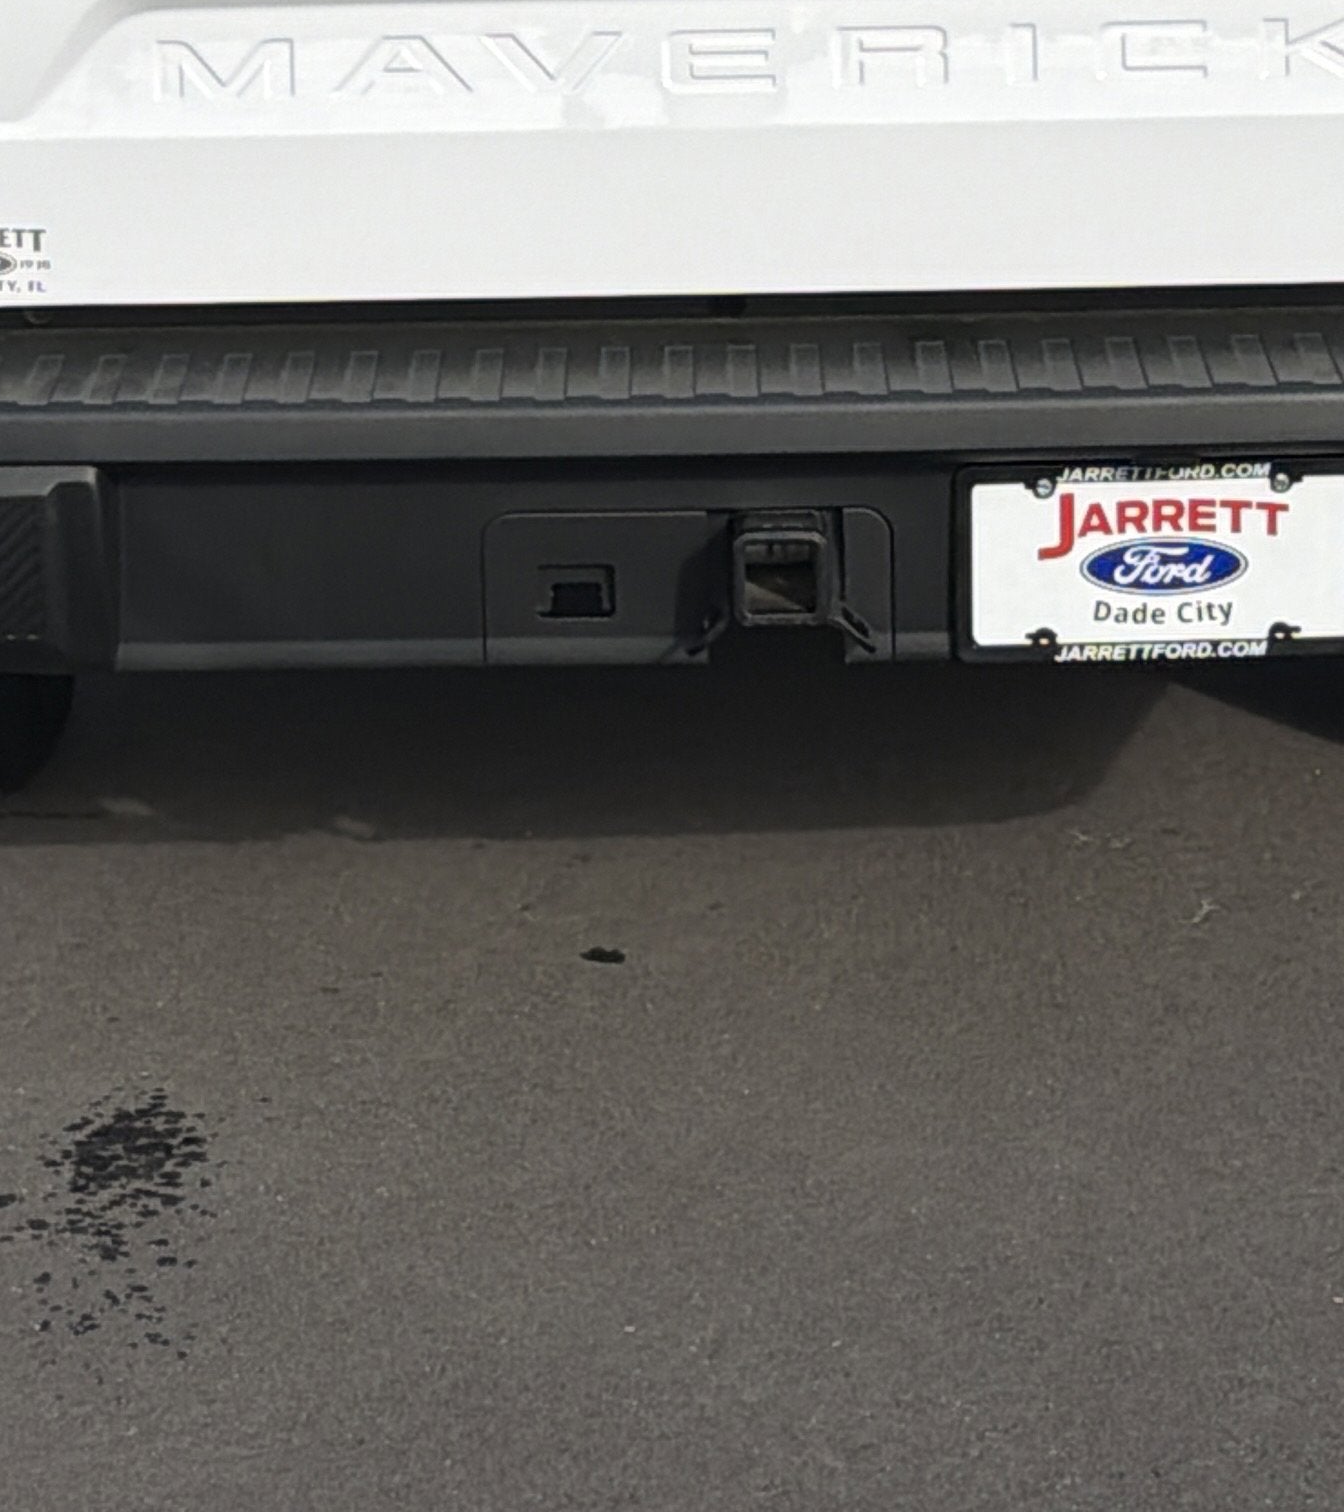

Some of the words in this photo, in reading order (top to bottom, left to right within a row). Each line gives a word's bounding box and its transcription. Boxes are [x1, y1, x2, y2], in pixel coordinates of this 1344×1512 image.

[1056, 462, 1271, 483] JARRETTFORD.COM
[1037, 492, 1290, 561] JARRETT
[1113, 544, 1214, 586] Ford
[1093, 600, 1166, 625] Dade
[1177, 600, 1234, 626] City
[1053, 640, 1269, 663] JARRETTFORD.COM
